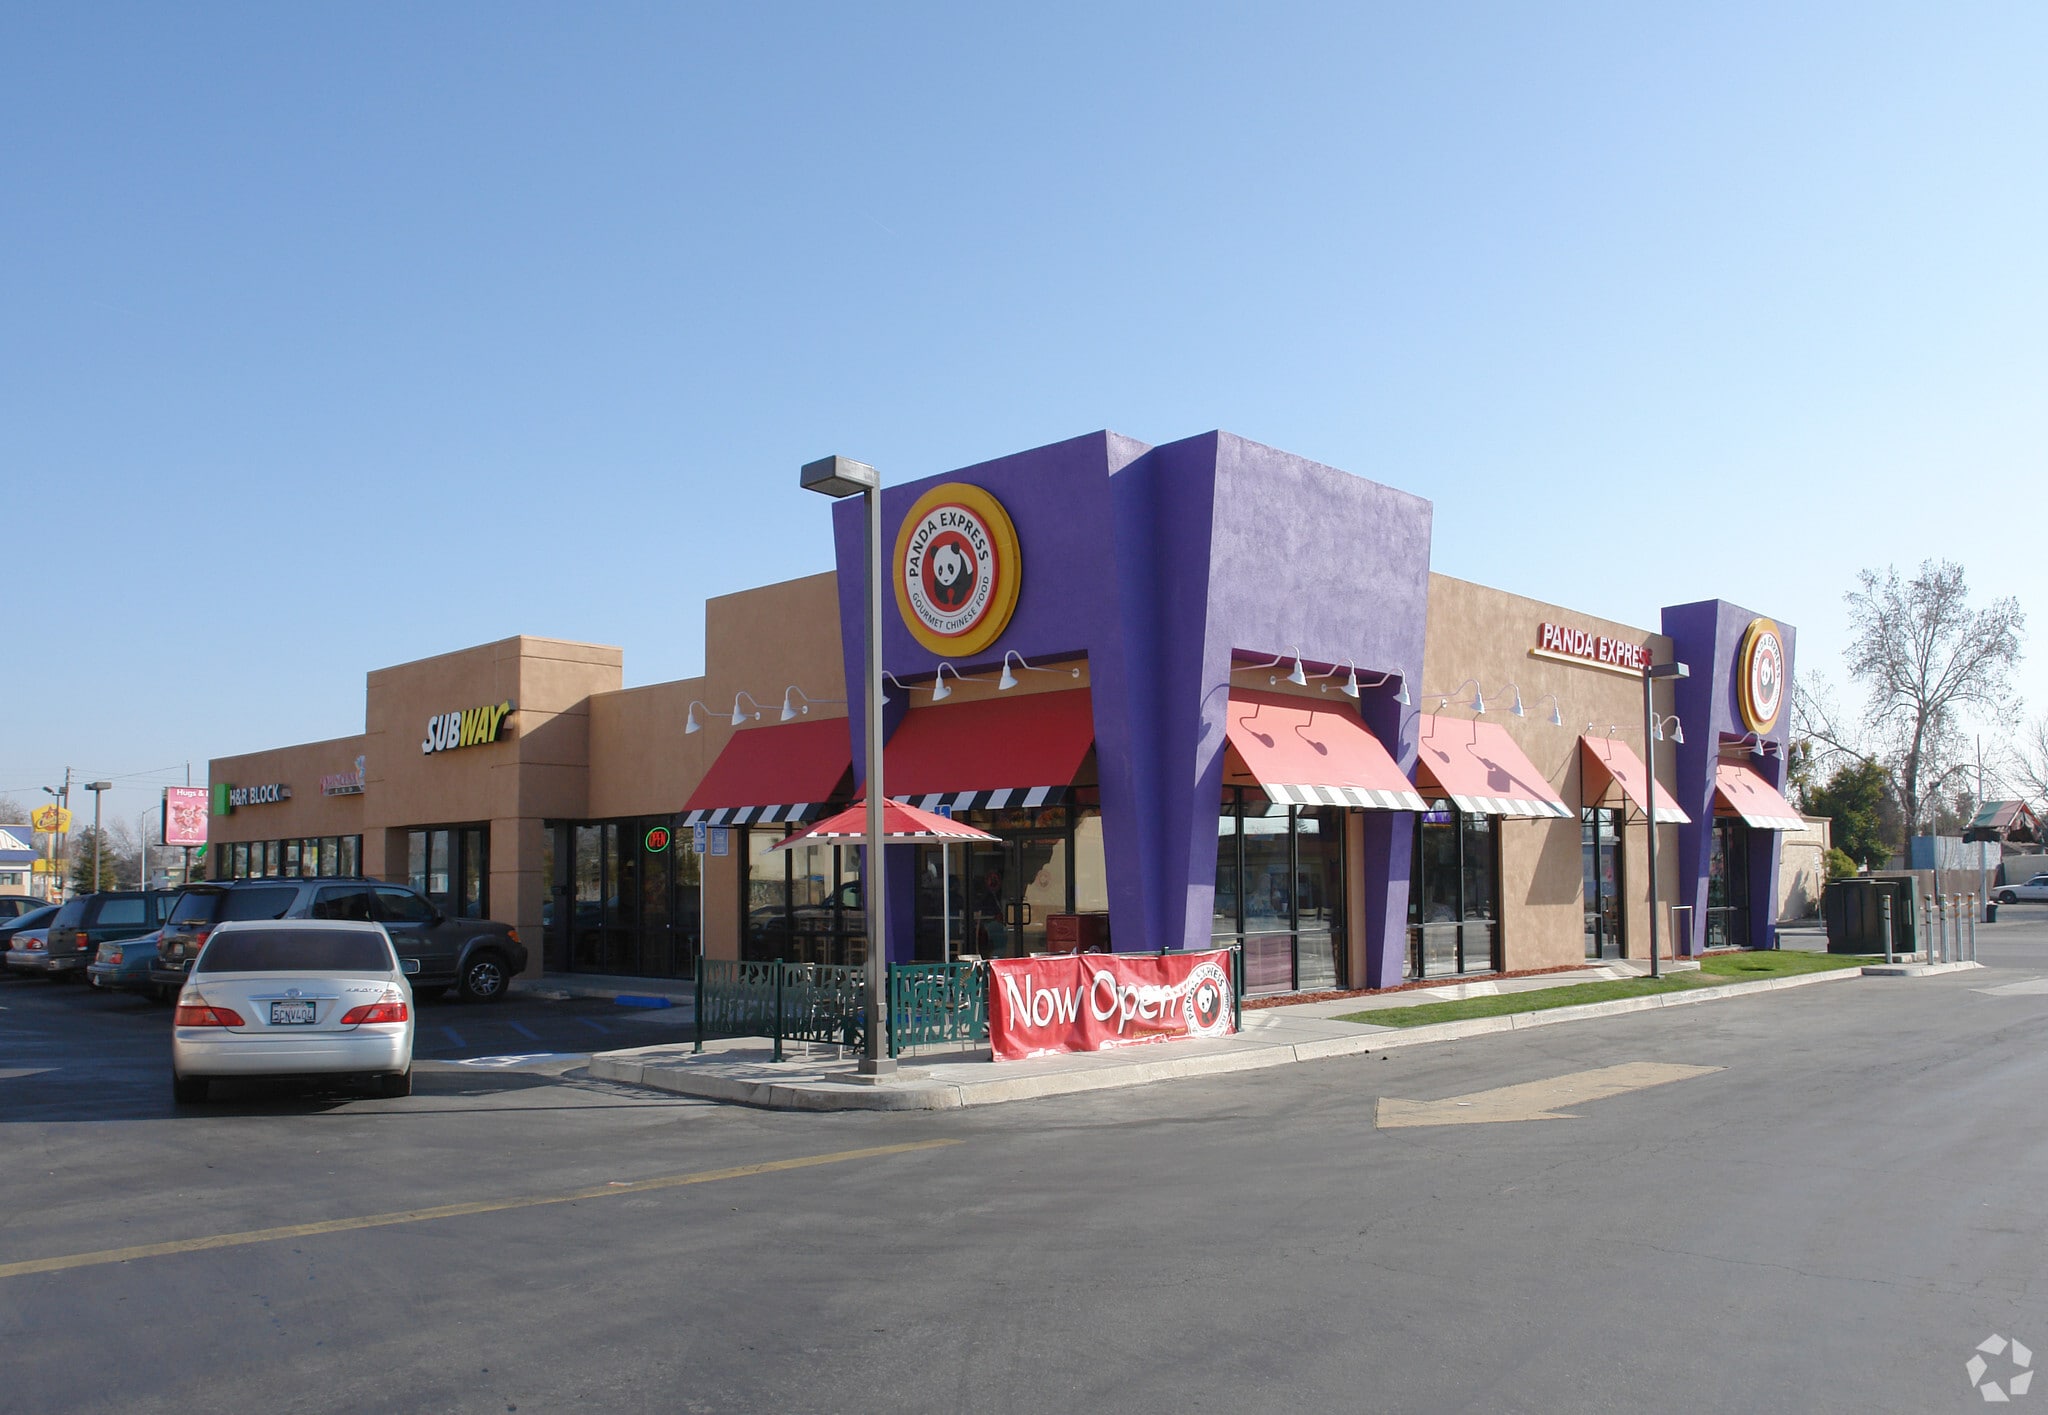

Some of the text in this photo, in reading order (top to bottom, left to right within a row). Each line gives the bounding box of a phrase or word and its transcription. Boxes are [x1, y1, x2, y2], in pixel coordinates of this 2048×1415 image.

[909, 511, 989, 578] PANDA EXPRESS
[912, 575, 990, 630] GOURMET CHINESE FOOD
[1541, 622, 1595, 658] PANDA
[421, 701, 510, 753] SUBWAY
[176, 788, 197, 798] Hugs
[198, 789, 204, 797] &
[229, 783, 280, 807] H&R BLOCK
[649, 830, 666, 848] OPEN
[1000, 969, 1178, 1035] Now Open
